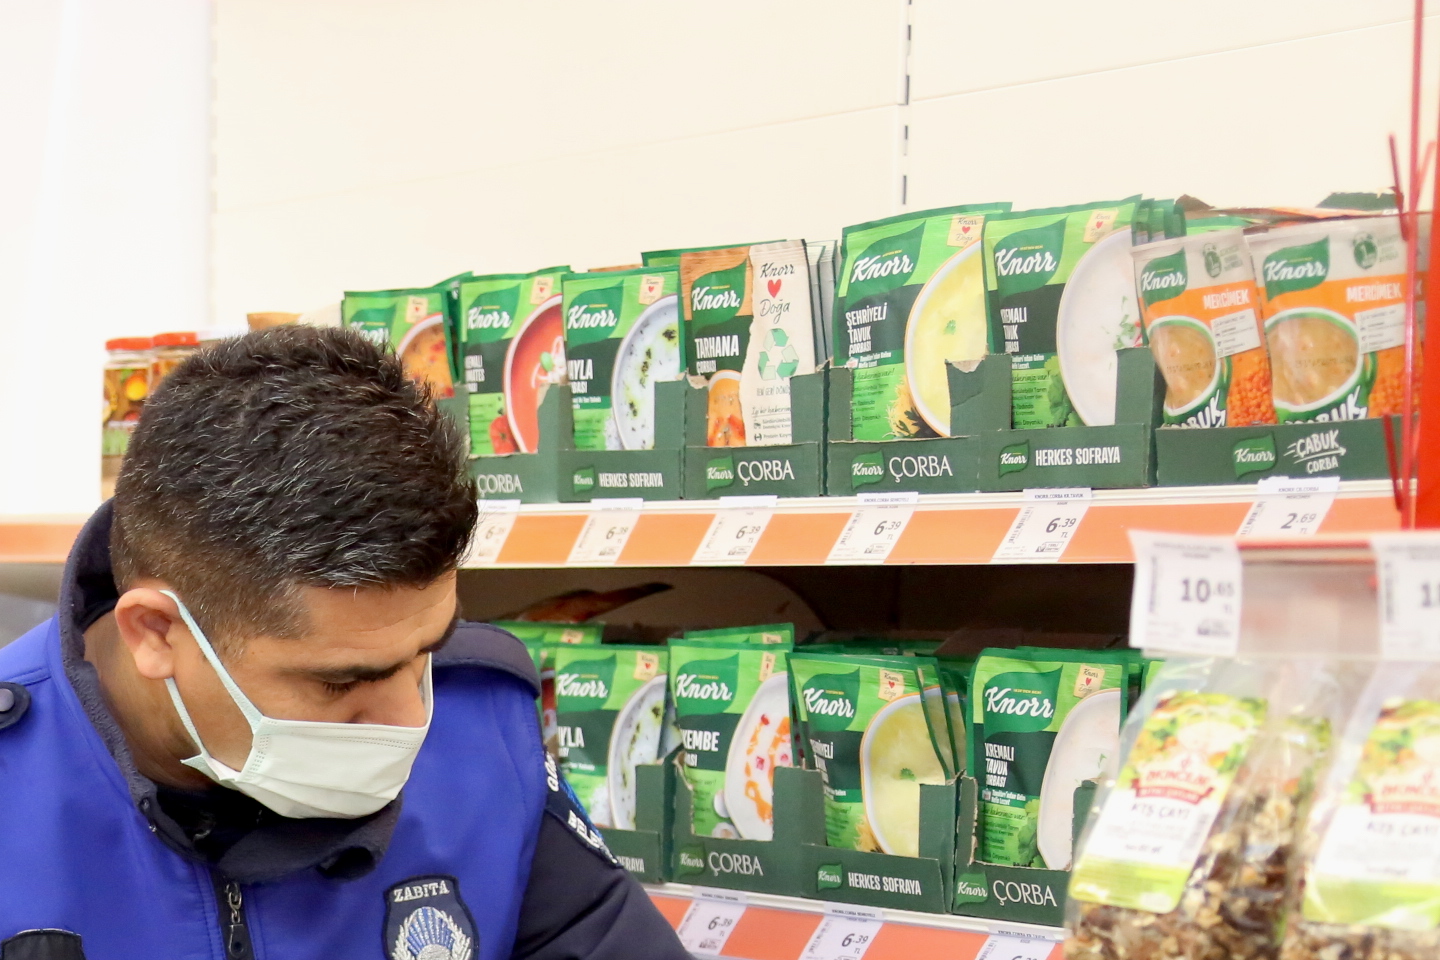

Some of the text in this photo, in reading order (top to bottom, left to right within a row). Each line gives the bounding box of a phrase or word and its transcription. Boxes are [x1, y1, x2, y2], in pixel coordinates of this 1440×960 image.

[760, 262, 796, 279] Knorr
[851, 254, 914, 284] Knorr
[994, 248, 1057, 277] Knorr
[1264, 260, 1327, 282] Knorr
[1141, 270, 1187, 292] Knorr
[692, 286, 740, 311] Knorr
[1203, 287, 1251, 310] MERCİMEK
[1346, 282, 1403, 303] MERCİMEK
[468, 307, 512, 330] Knorr
[567, 304, 617, 329] Knorr
[759, 299, 791, 324] Doğa
[845, 302, 888, 329] ŞEHRİYELİ
[847, 325, 871, 343] TAVUK
[694, 335, 740, 359] TARHANA
[1296, 430, 1340, 458] ÇABUK
[1000, 452, 1027, 466] Knorr
[1035, 446, 1121, 467] HERKES SOFRAYA
[1234, 448, 1275, 463] Knorr
[1307, 457, 1339, 475] ÇORBA
[574, 473, 594, 486] Knorr
[599, 472, 664, 488] HERKES SOFRAYA
[707, 467, 734, 481] Knorr
[737, 459, 795, 486] ÇORBA
[852, 461, 884, 477] Knorr
[889, 455, 953, 483] ÇORBA
[477, 474, 523, 496] ÇORBA
[735, 525, 761, 540] 6.39
[873, 520, 902, 536] 6.39
[1045, 517, 1077, 533] 6.39
[1280, 512, 1318, 531] 2.69
[1060, 531, 1069, 539] TL
[556, 673, 608, 699] Knorr
[676, 673, 733, 701] Knorr
[803, 687, 855, 718] Knorr
[985, 686, 1054, 719] Knorr
[682, 730, 720, 753] KEMBE
[984, 742, 1015, 761] KREMALI
[680, 853, 704, 869] Knorr
[708, 850, 764, 877] ÇORBA
[818, 869, 842, 885] Knorr
[847, 872, 922, 896] HERKES SOFRAYA
[957, 881, 989, 898] Knorr
[993, 880, 1058, 908] ÇORBA
[708, 916, 733, 931] 6.39
[841, 933, 869, 948] 6.39
